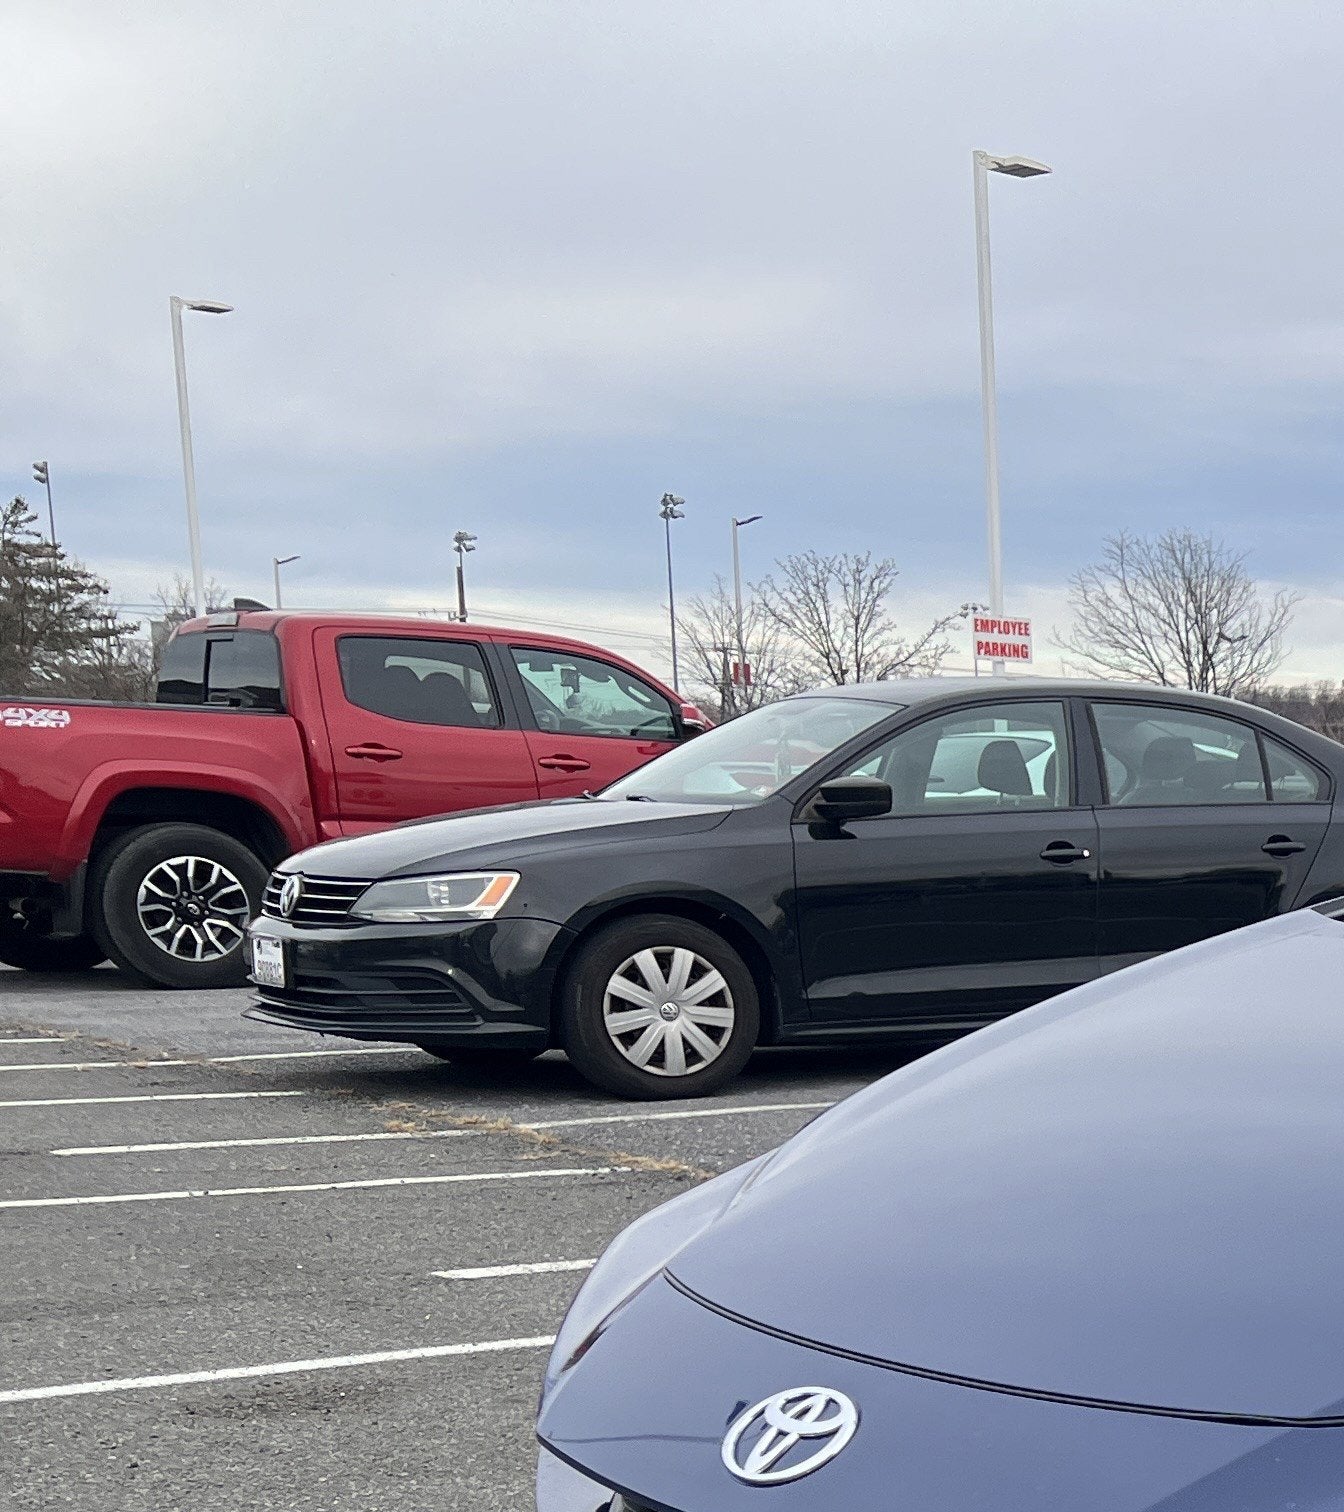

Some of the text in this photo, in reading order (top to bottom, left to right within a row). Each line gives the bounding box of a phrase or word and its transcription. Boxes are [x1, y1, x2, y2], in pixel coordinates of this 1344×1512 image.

[974, 618, 1030, 637] EMPLOYEE
[977, 640, 1029, 659] PARKING
[2, 707, 71, 725] 4X4
